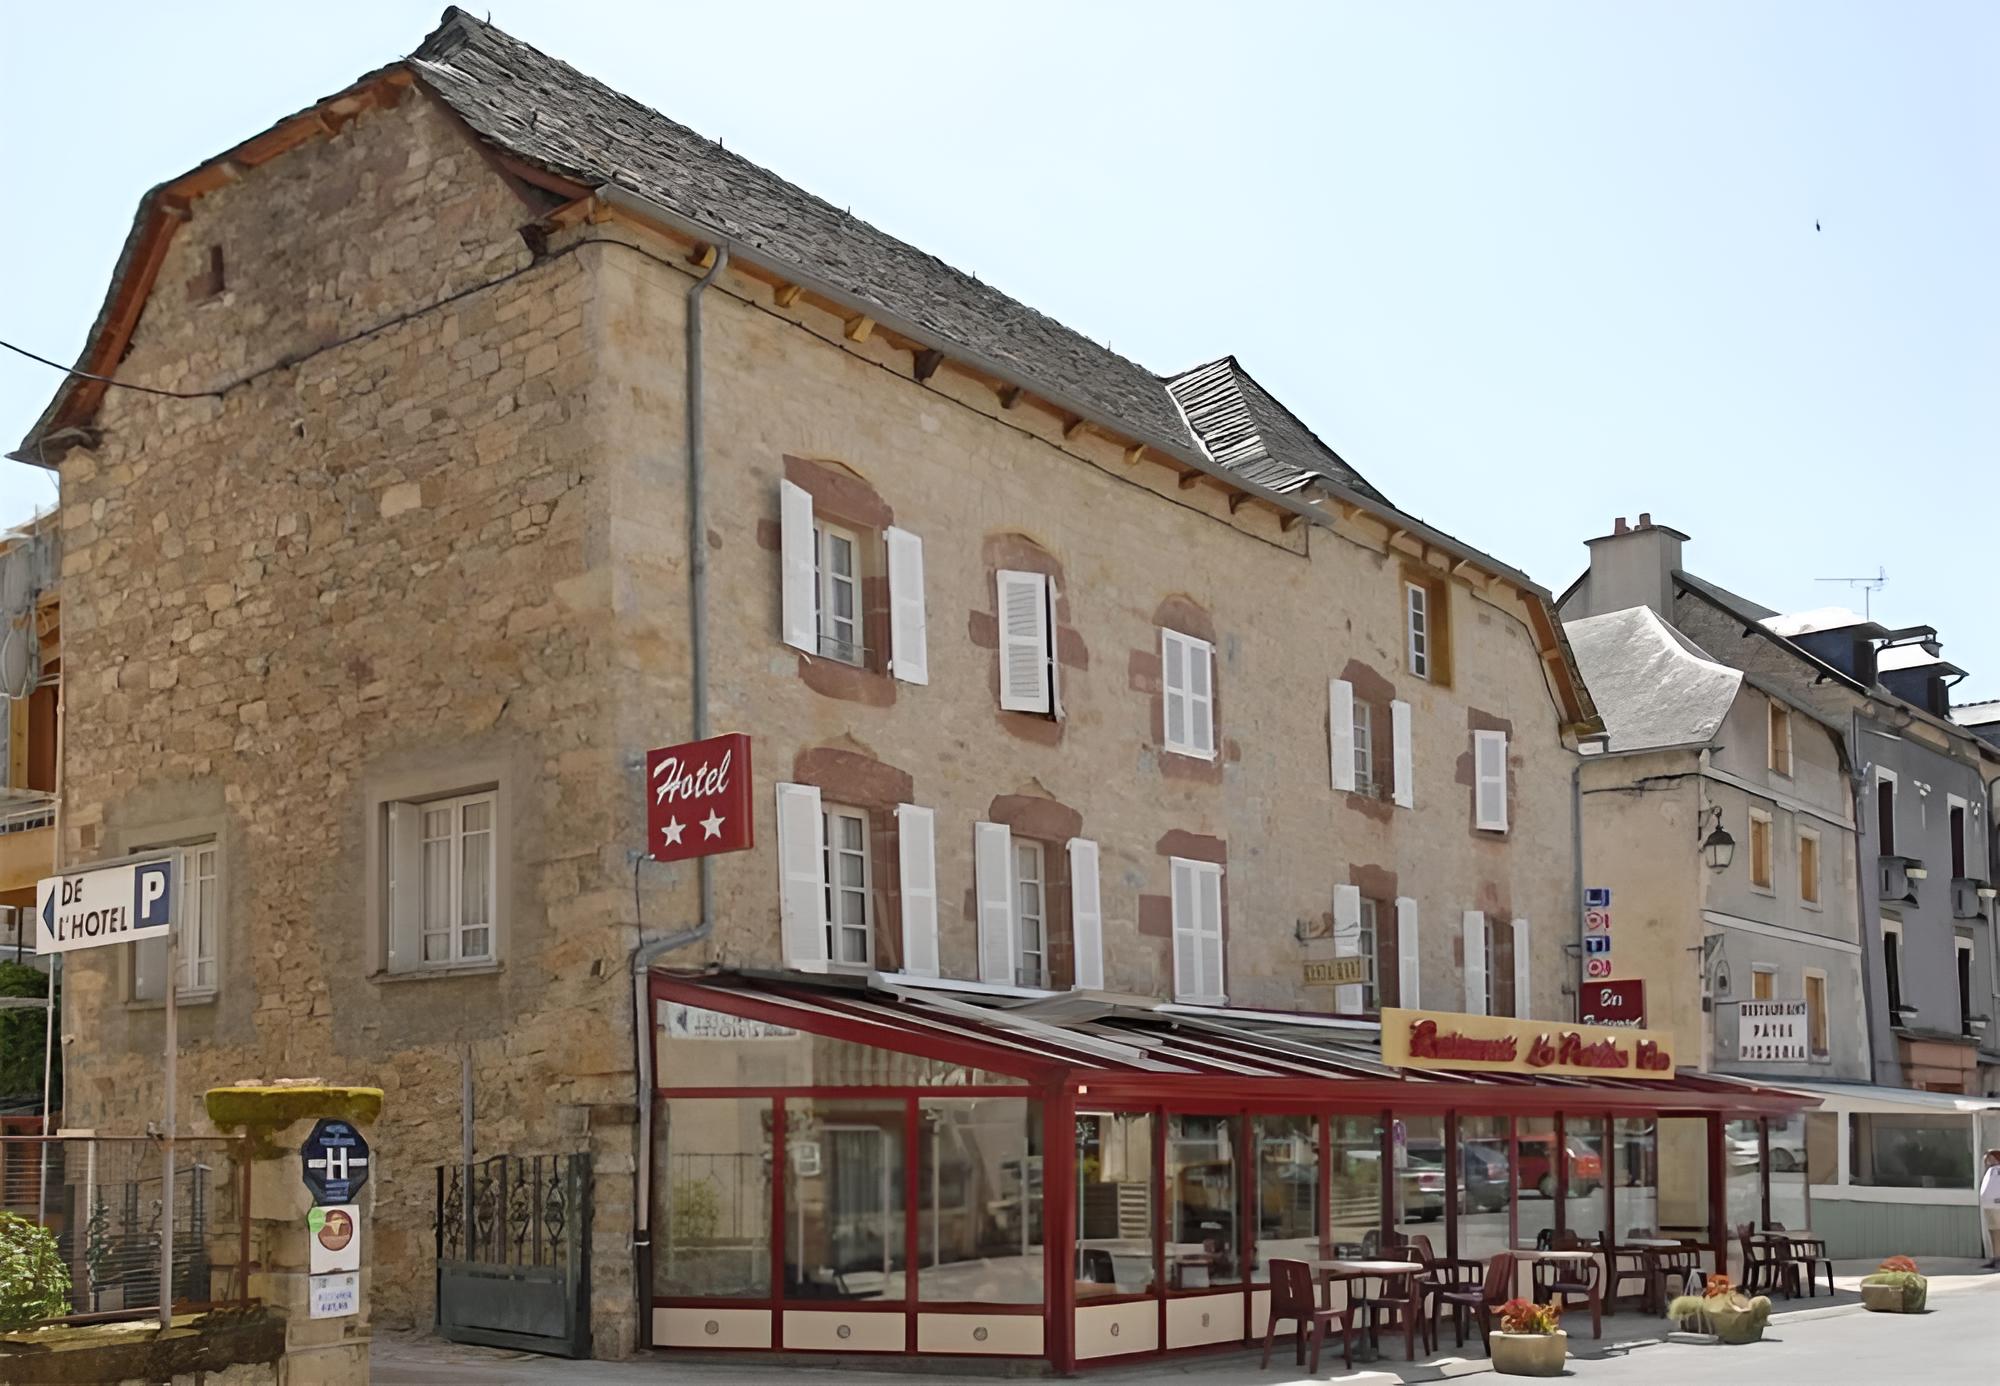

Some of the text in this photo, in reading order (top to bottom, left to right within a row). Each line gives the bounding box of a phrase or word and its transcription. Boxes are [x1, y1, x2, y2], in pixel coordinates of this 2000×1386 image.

[653, 749, 731, 806] Hotel
[61, 878, 83, 906] DE
[141, 871, 165, 919] P
[58, 906, 128, 941] L'HOTEL
